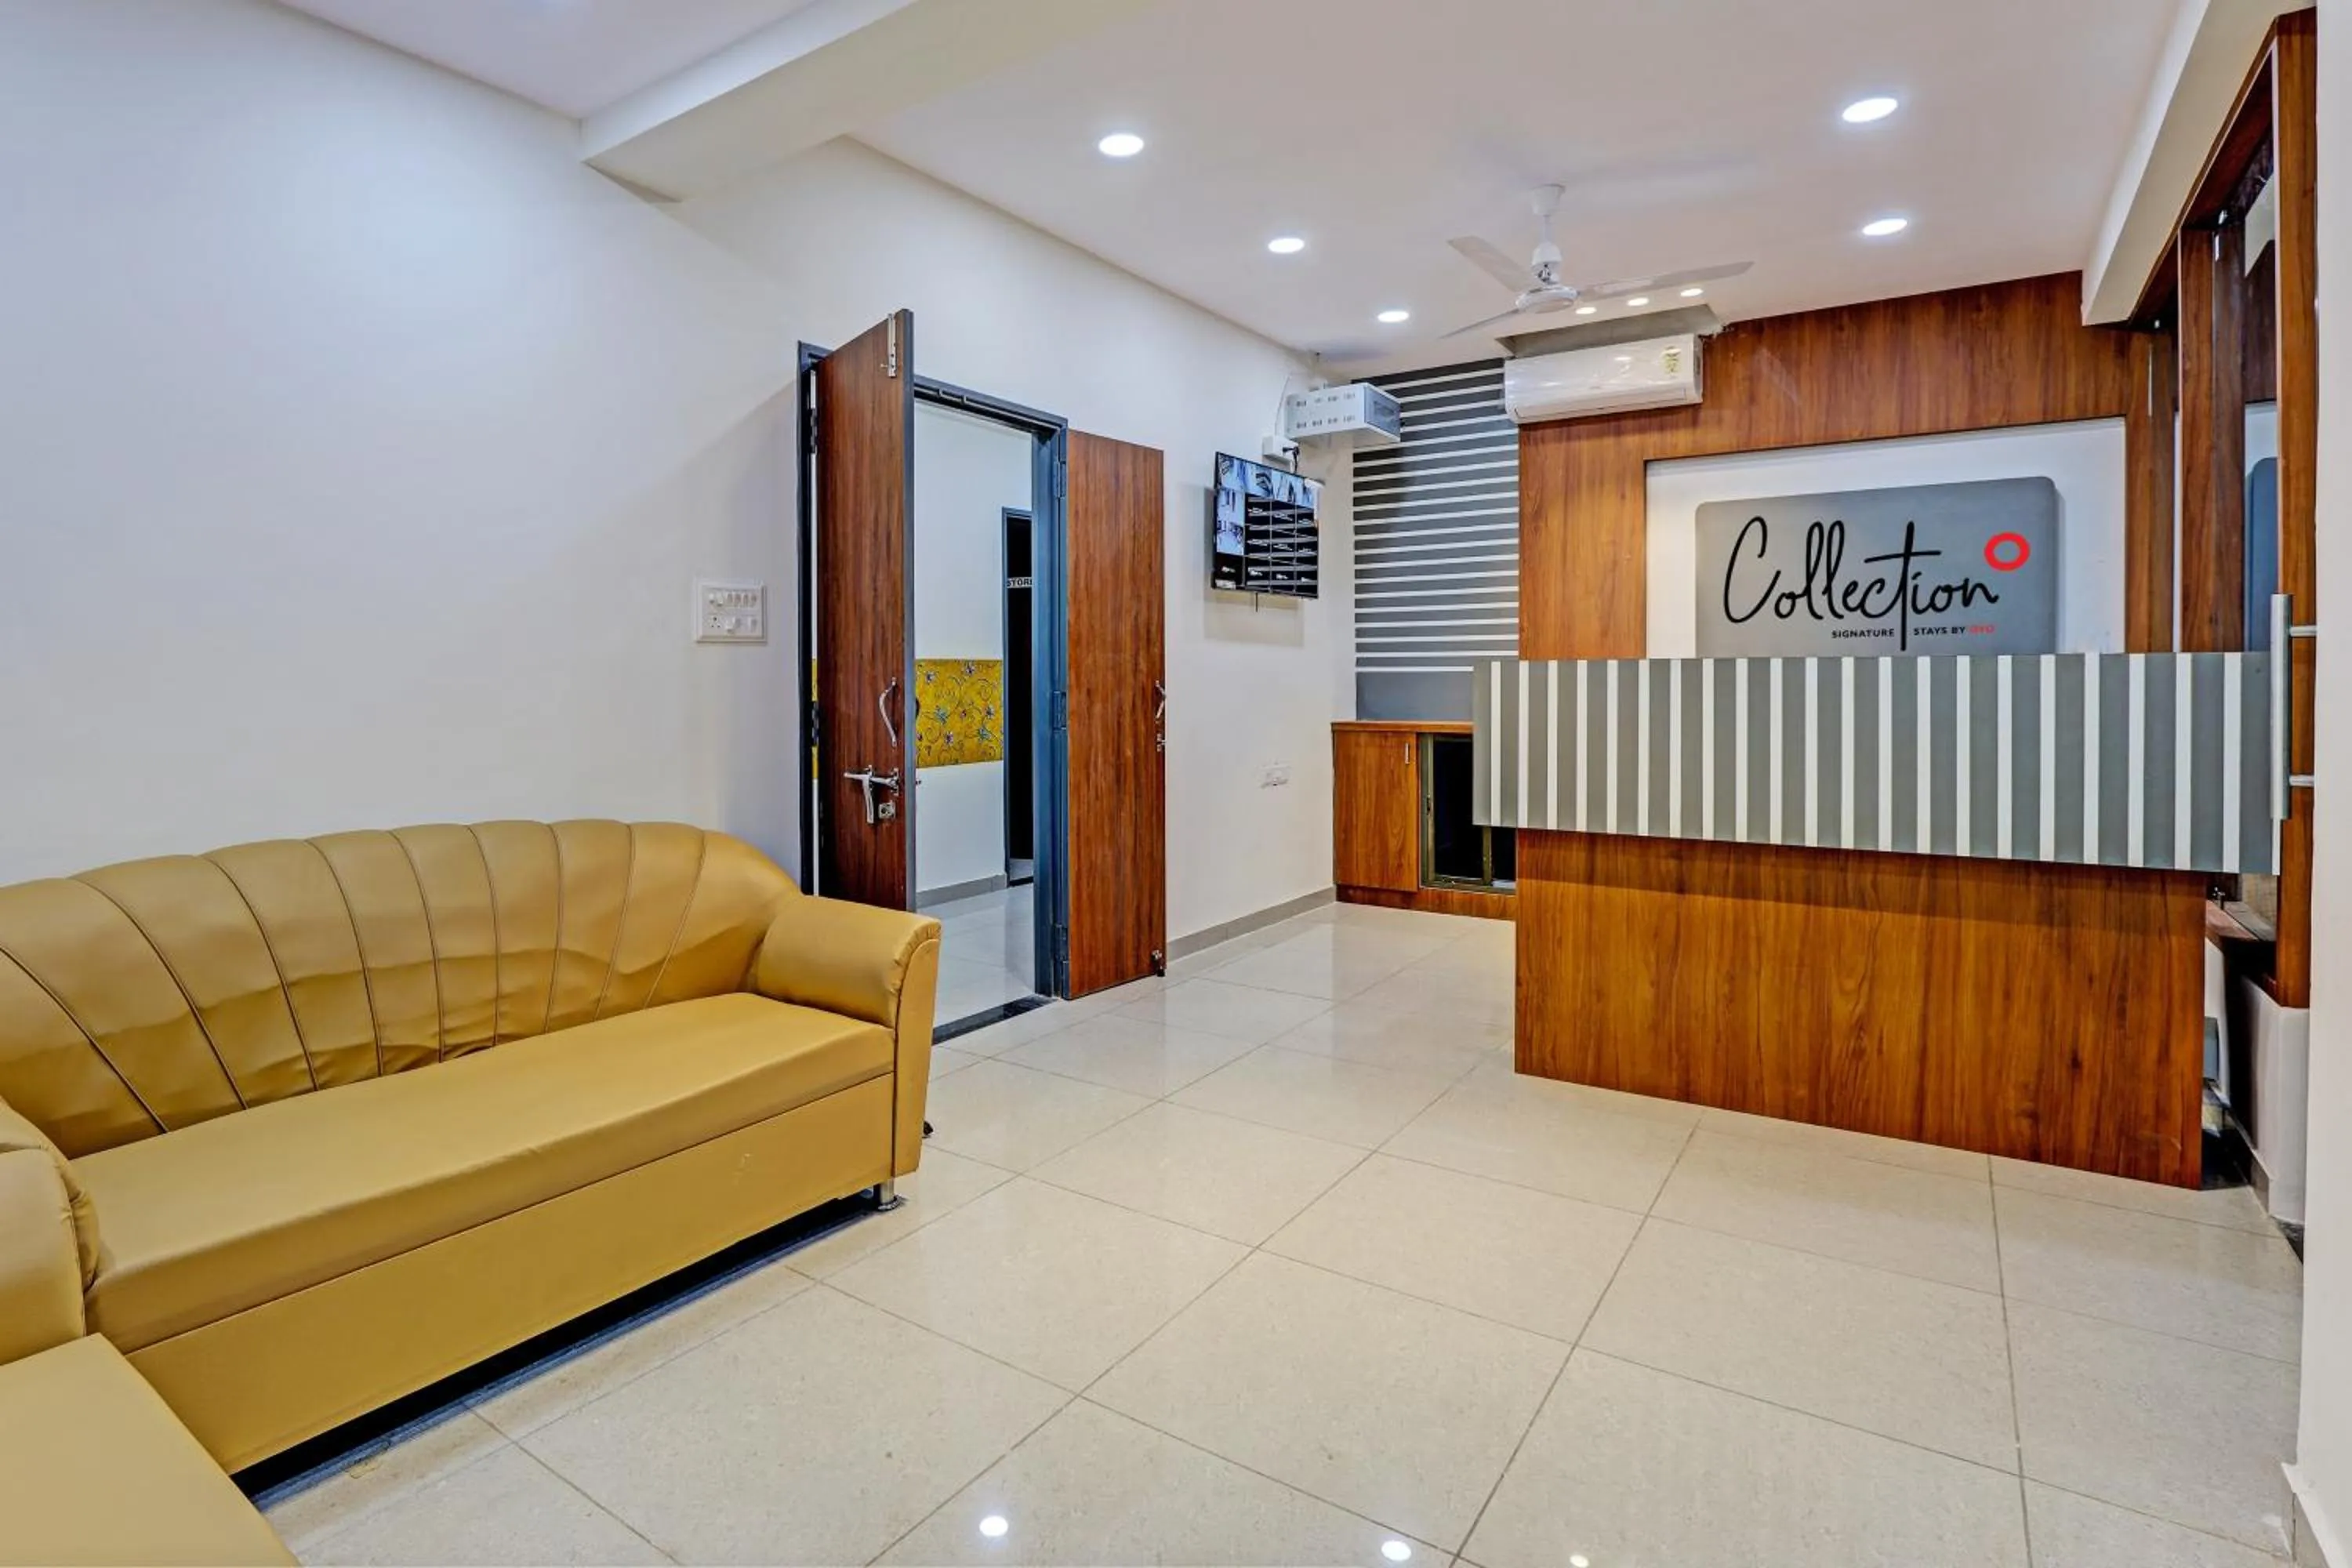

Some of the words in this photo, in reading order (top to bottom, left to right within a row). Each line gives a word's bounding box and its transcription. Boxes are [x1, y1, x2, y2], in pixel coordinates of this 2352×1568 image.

[1723, 516, 1999, 652] Collection
[1831, 628, 1895, 639] SIGNATURE
[1914, 626, 1947, 636] STAYS
